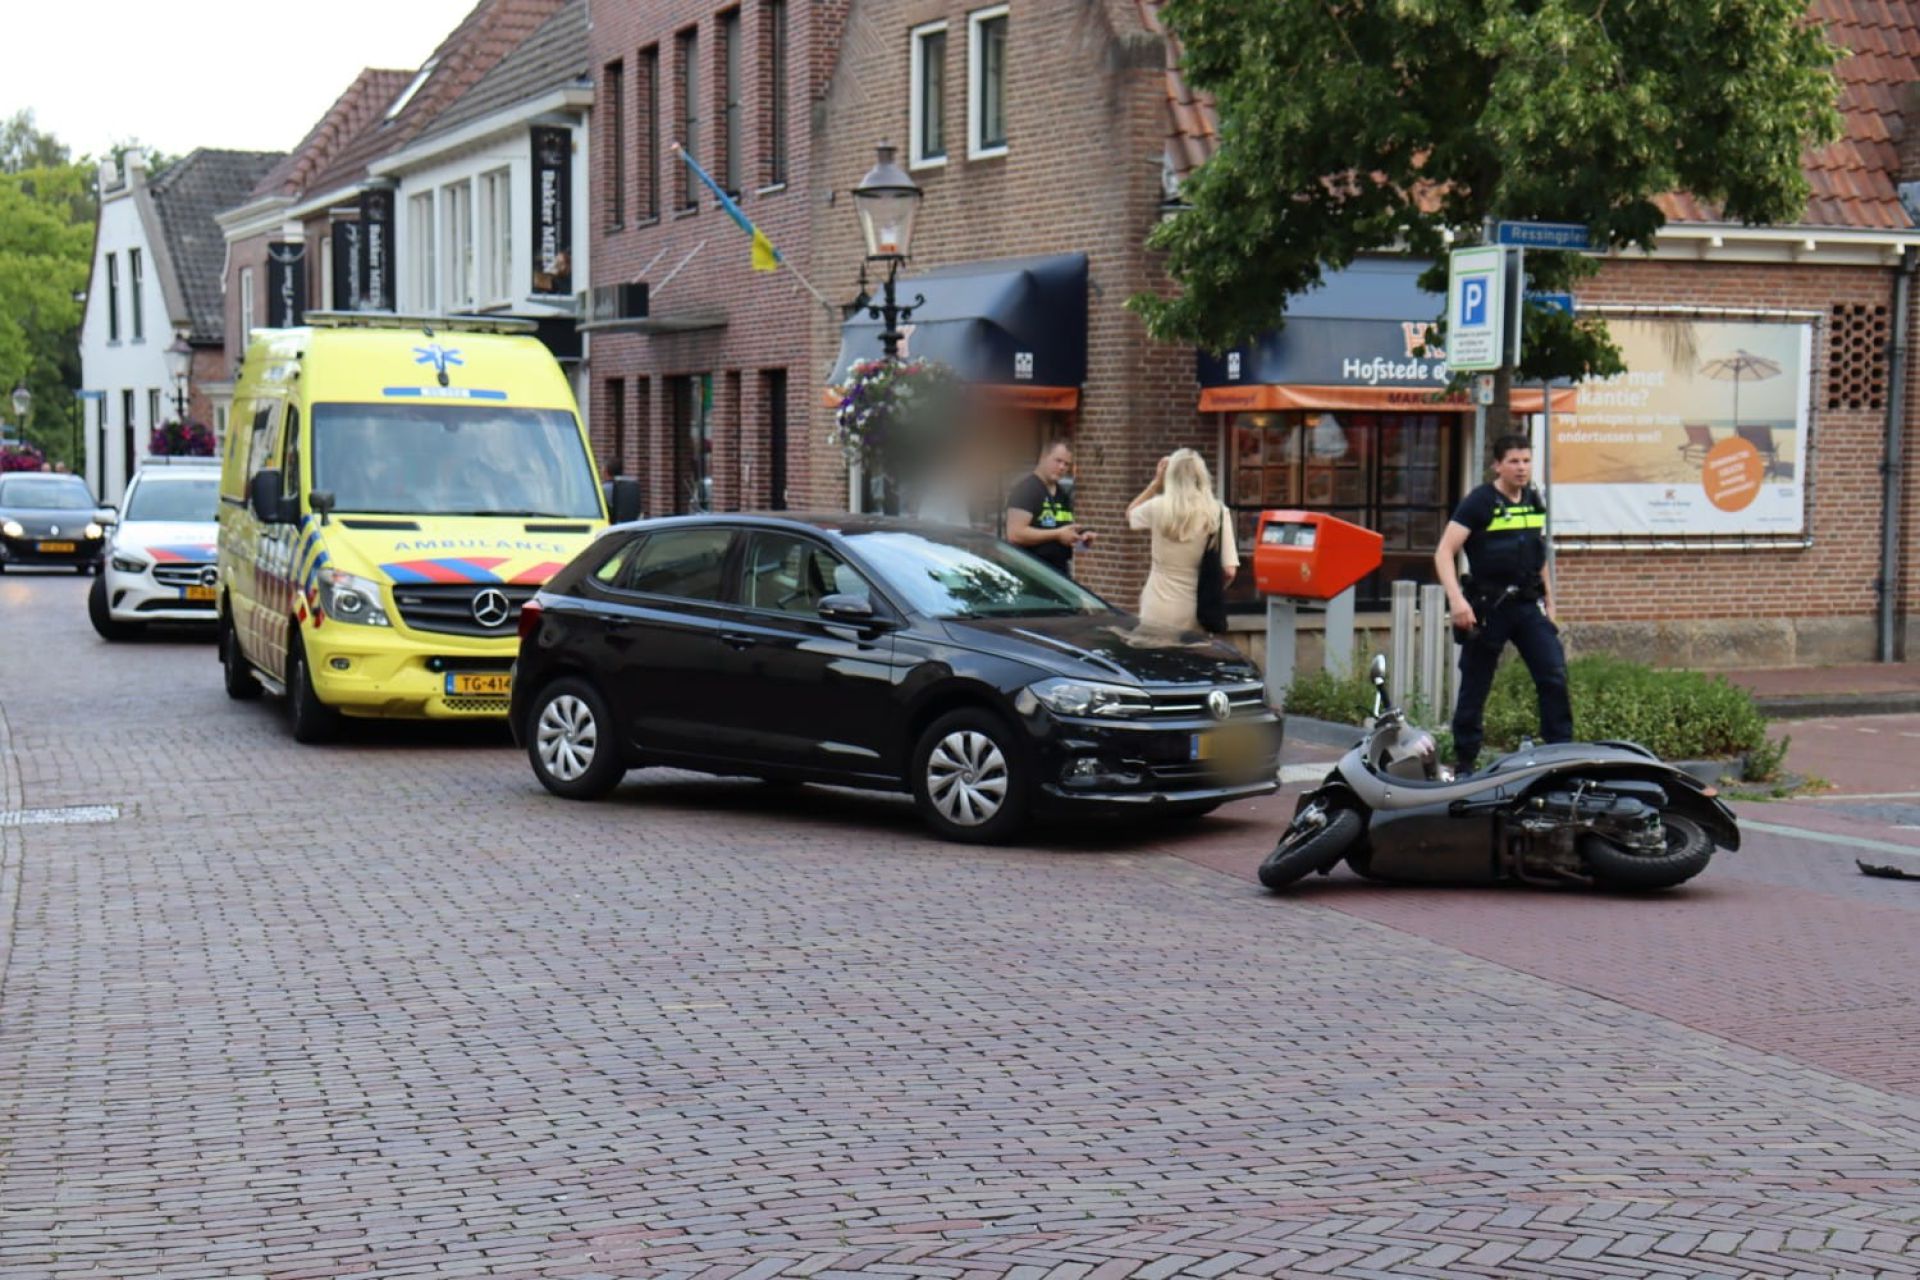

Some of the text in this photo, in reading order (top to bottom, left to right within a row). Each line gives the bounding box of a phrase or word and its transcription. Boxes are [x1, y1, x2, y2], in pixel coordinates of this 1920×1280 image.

[1465, 283, 1482, 321] P
[1342, 357, 1428, 385] Hofstede
[1557, 431, 1634, 443] ondertussen
[394, 539, 567, 555] AMBULANCE
